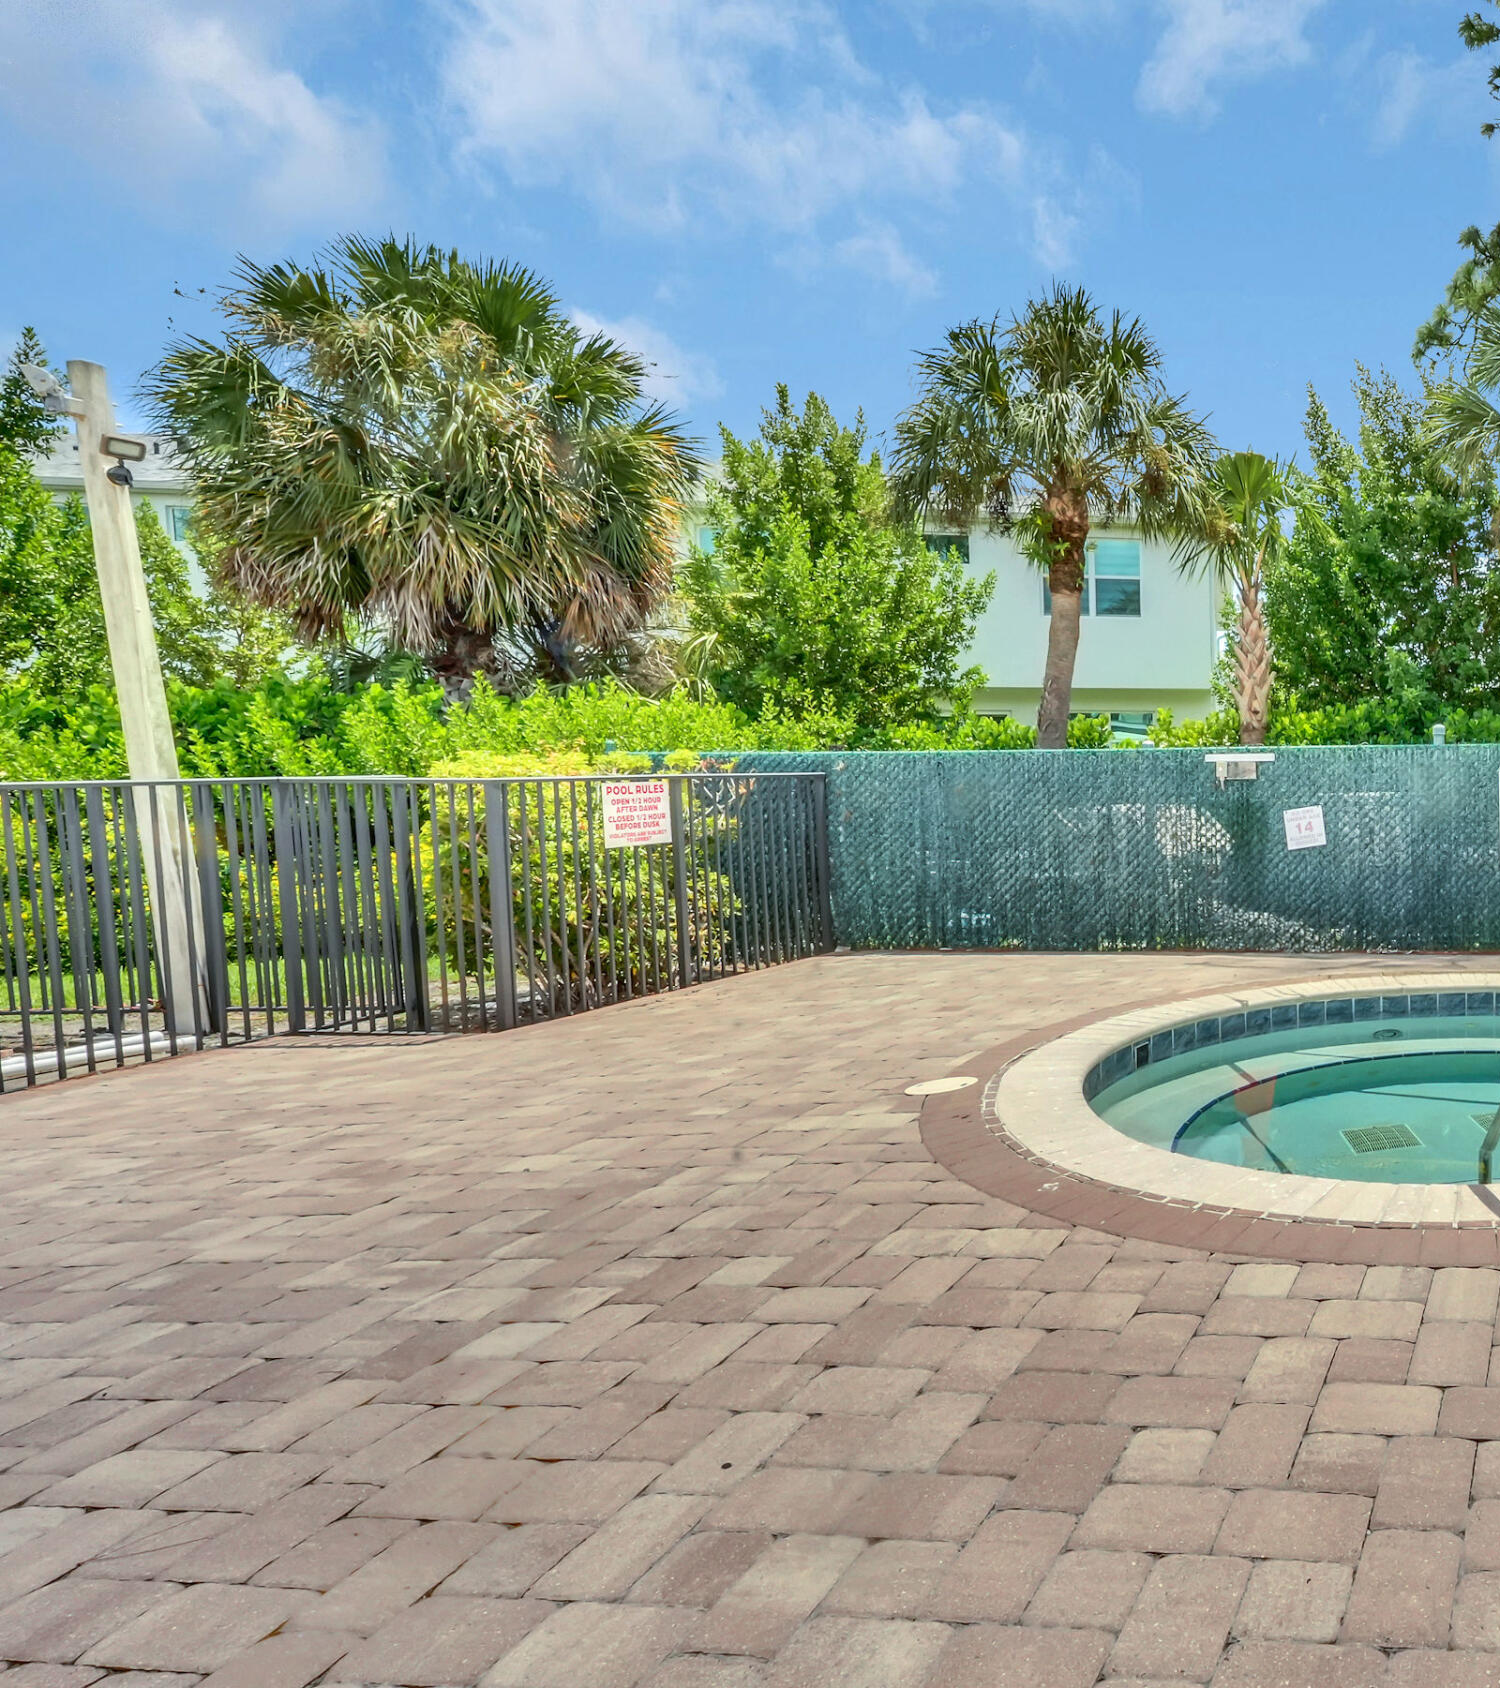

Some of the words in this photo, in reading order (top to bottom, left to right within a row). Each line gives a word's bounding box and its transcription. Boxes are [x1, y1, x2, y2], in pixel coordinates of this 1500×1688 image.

[606, 785, 633, 795] POOL
[635, 784, 664, 794] RULES
[611, 798, 630, 806] OPEN
[643, 796, 661, 804] HOUR
[616, 805, 637, 813] AFTER
[639, 804, 658, 812] DAWN
[608, 815, 635, 823] CLOSED
[636, 813, 647, 821] 1/2
[648, 812, 666, 820] HOUR
[615, 822, 641, 830] BEFORE
[643, 820, 660, 828] DUSK
[1296, 821, 1313, 834] 14
